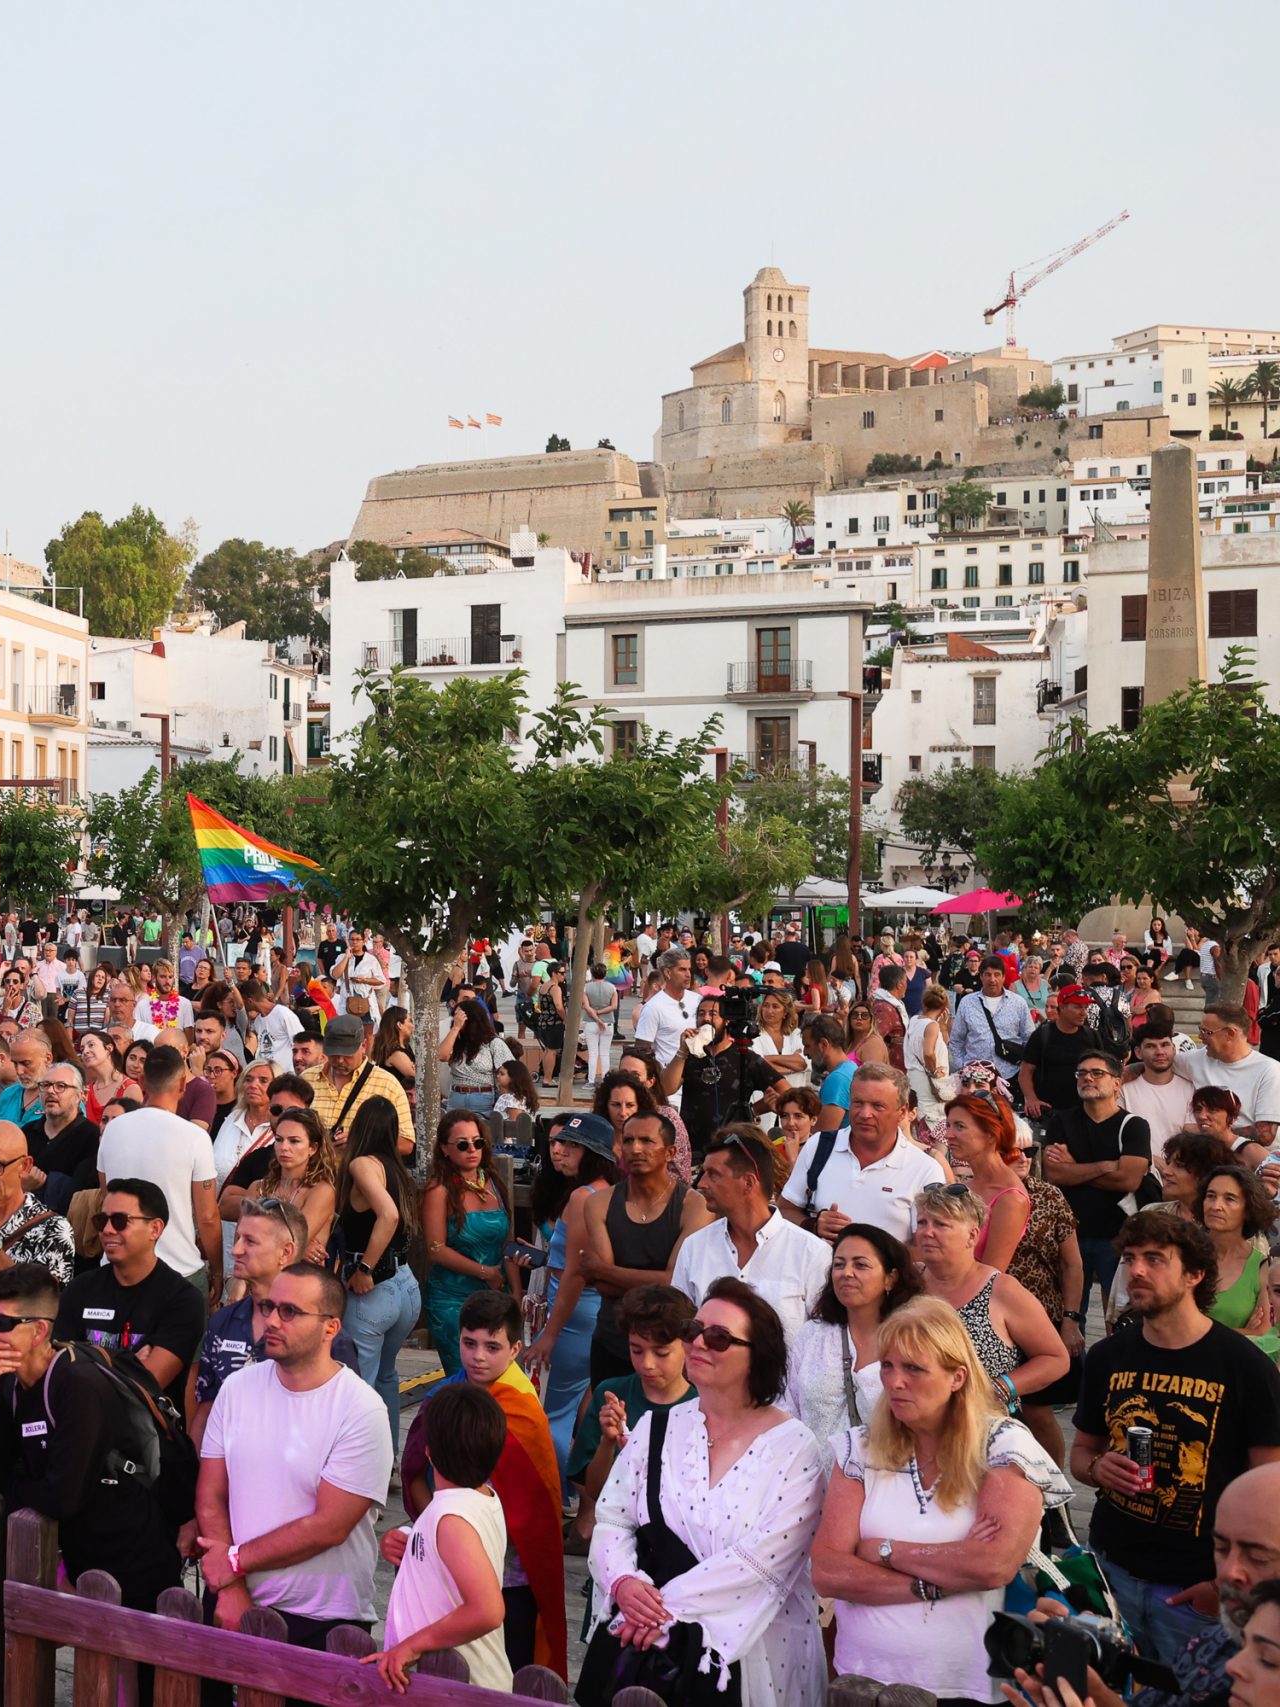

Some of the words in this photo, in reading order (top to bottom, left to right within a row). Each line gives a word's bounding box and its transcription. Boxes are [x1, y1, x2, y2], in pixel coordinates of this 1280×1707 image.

[1152, 587, 1192, 602] IBIZA
[1168, 605, 1176, 613] A
[1161, 615, 1183, 623] SUS
[1148, 626, 1194, 639] CORSARIOS
[243, 844, 284, 869] PRIDE
[1109, 1371, 1137, 1391] THE
[1142, 1372, 1225, 1403] LIZARDS!
